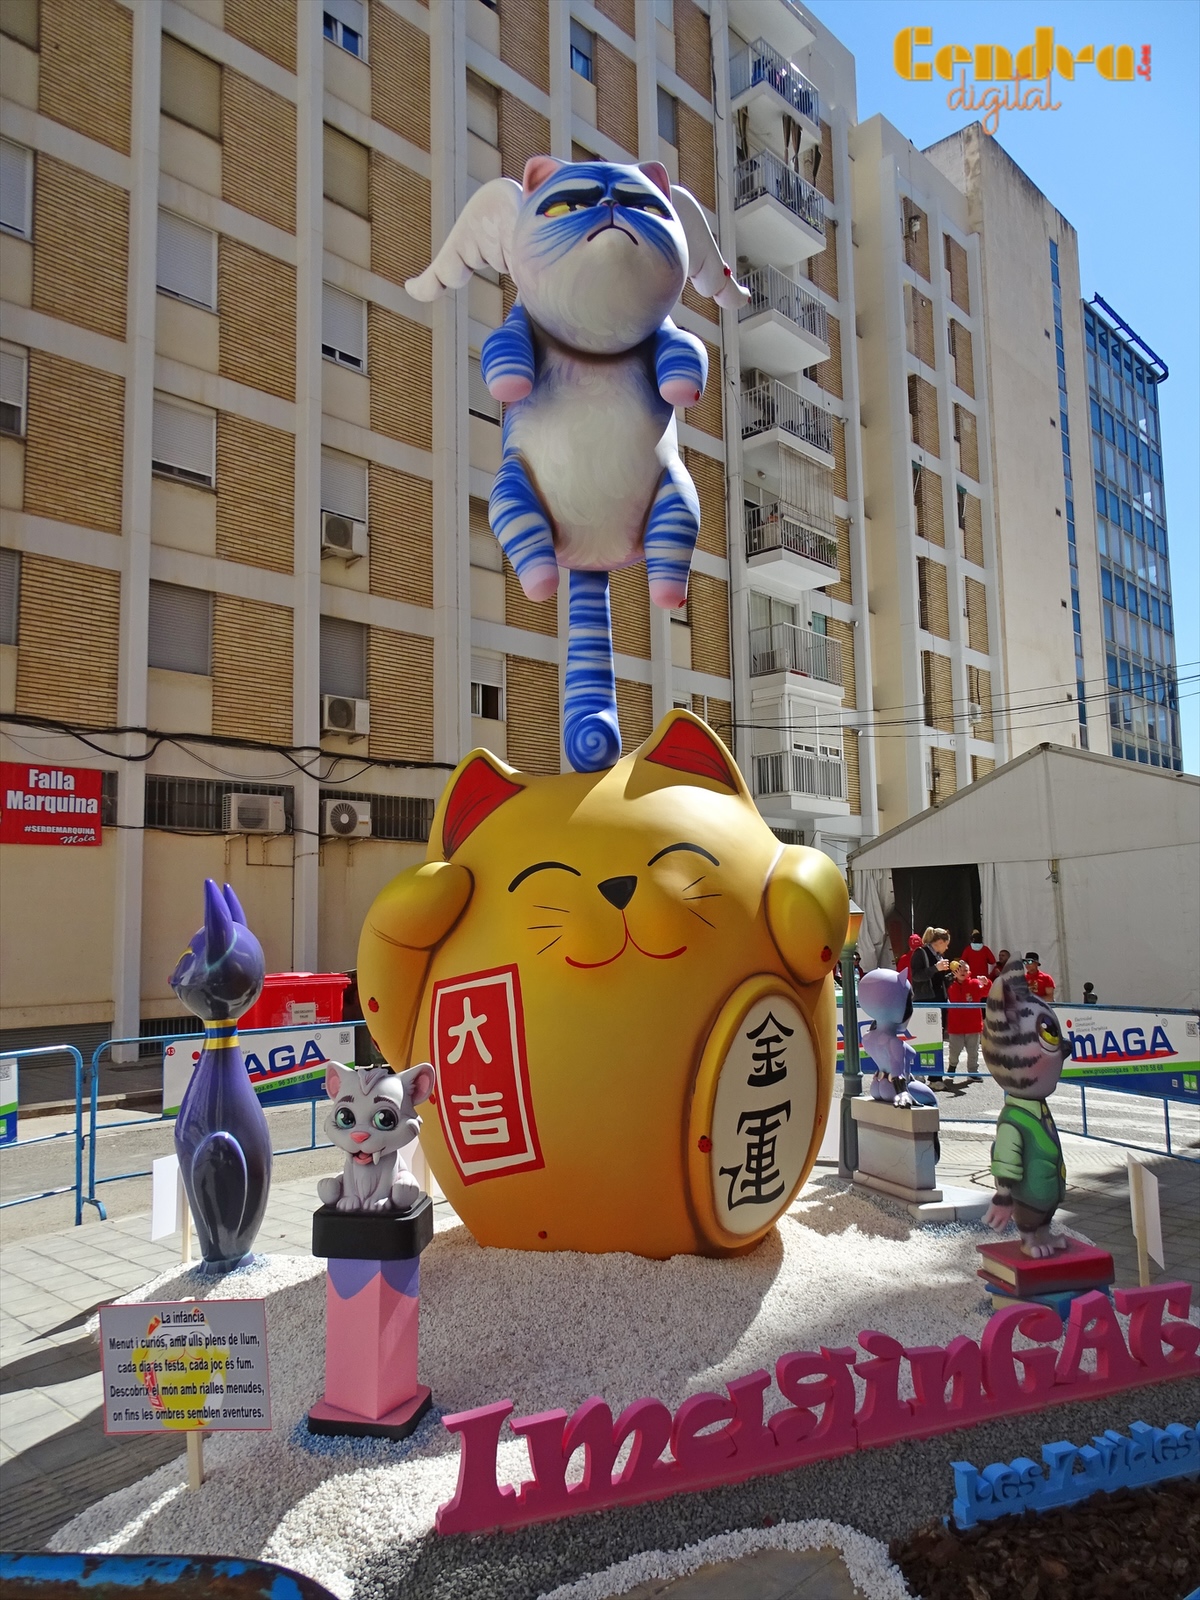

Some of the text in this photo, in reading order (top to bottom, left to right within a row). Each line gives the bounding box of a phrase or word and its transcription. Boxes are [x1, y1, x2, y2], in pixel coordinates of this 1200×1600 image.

[29, 768, 75, 791] Falla
[6, 789, 98, 814] Marquina
[24, 825, 95, 835] #SERDEMARQUINA
[60, 834, 96, 844] Mola
[446, 996, 511, 1146] 大吉
[161, 1311, 171, 1324] La
[109, 1332, 260, 1350] Menut i curiós, amb ulls plens de llum,
[117, 1362, 137, 1374] cada
[153, 1360, 163, 1372] és
[164, 1359, 187, 1373] festa,
[189, 1358, 209, 1371] cada
[210, 1358, 223, 1373] joc
[225, 1357, 235, 1370] és
[236, 1357, 255, 1370] fum.
[110, 1381, 265, 1398] Descobrix el món amb rialles menudes,
[112, 1406, 265, 1421] on fins les ombres semblen aventures.
